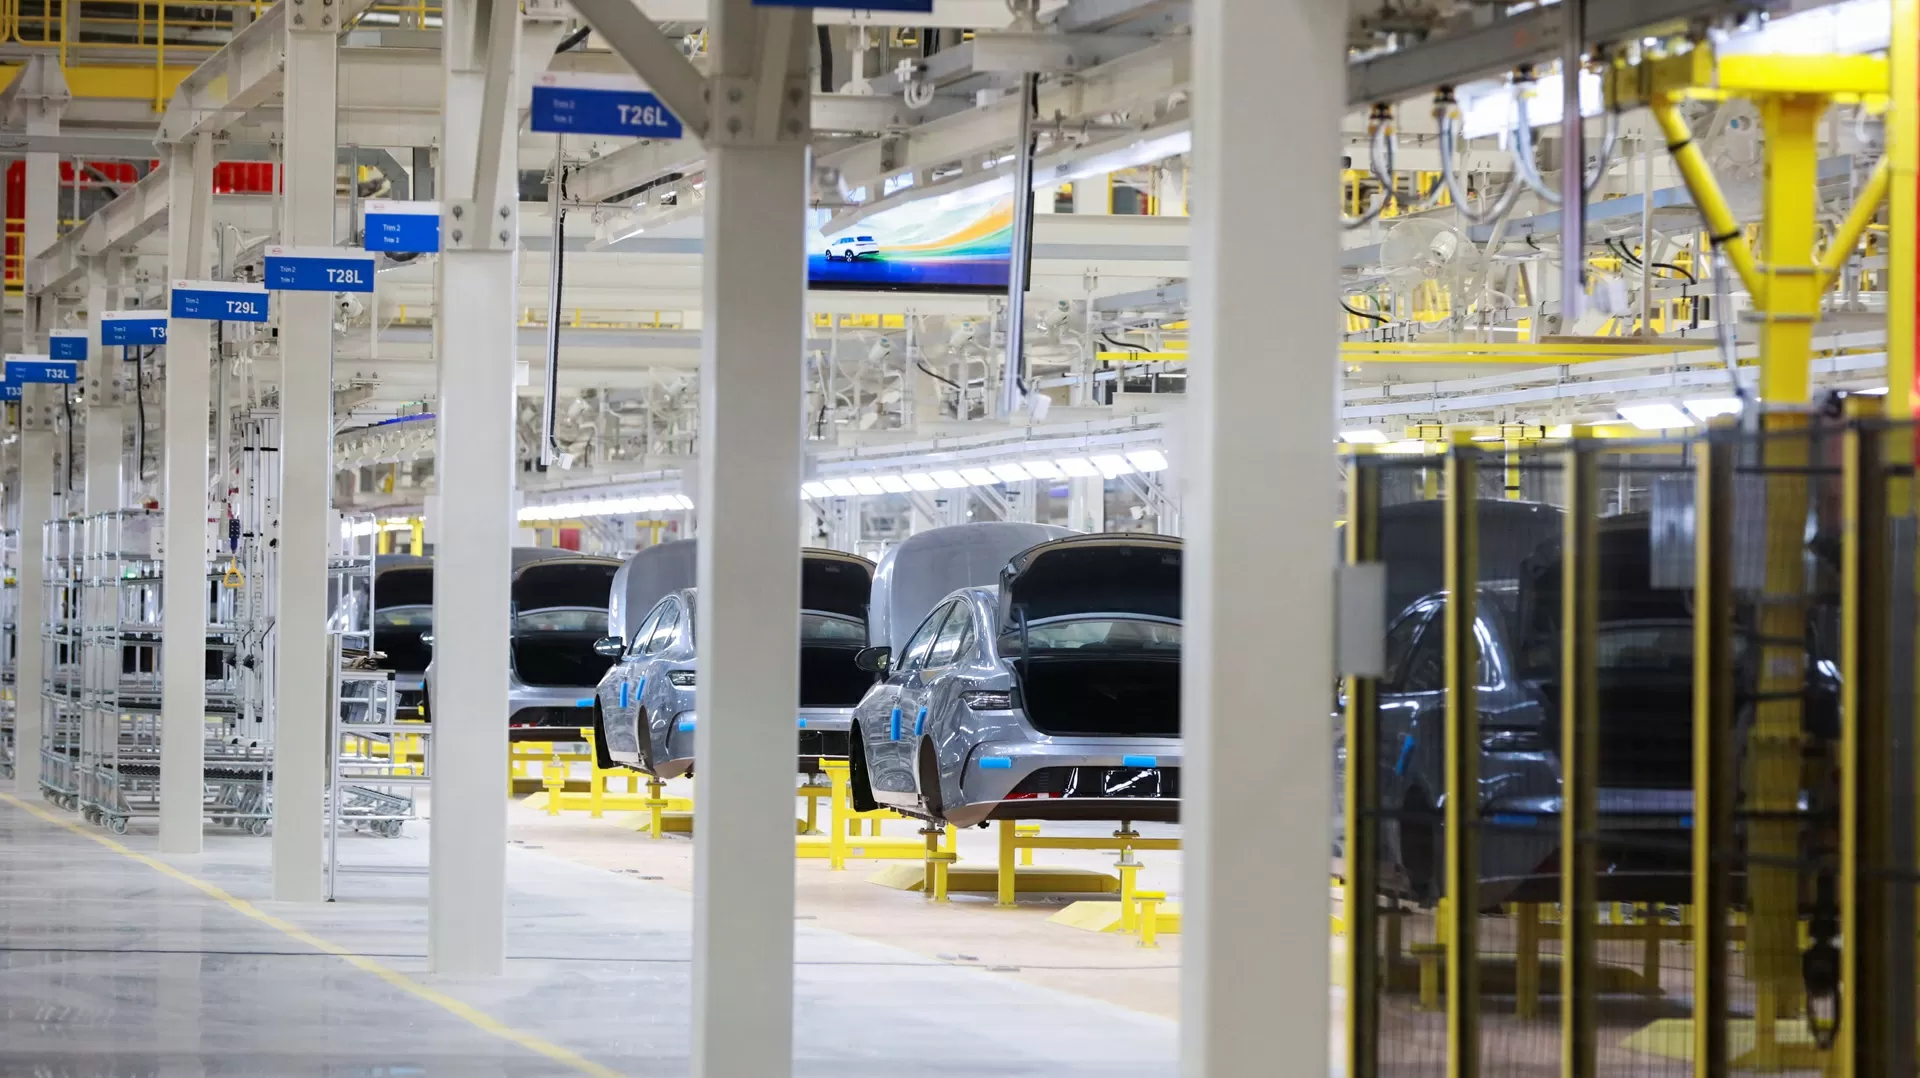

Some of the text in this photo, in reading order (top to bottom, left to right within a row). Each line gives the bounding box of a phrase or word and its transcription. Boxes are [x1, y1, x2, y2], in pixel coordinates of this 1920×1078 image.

[618, 105, 668, 126] T26L
[326, 268, 363, 284] T28L
[226, 301, 258, 314] T29L
[45, 368, 70, 379] T32L
